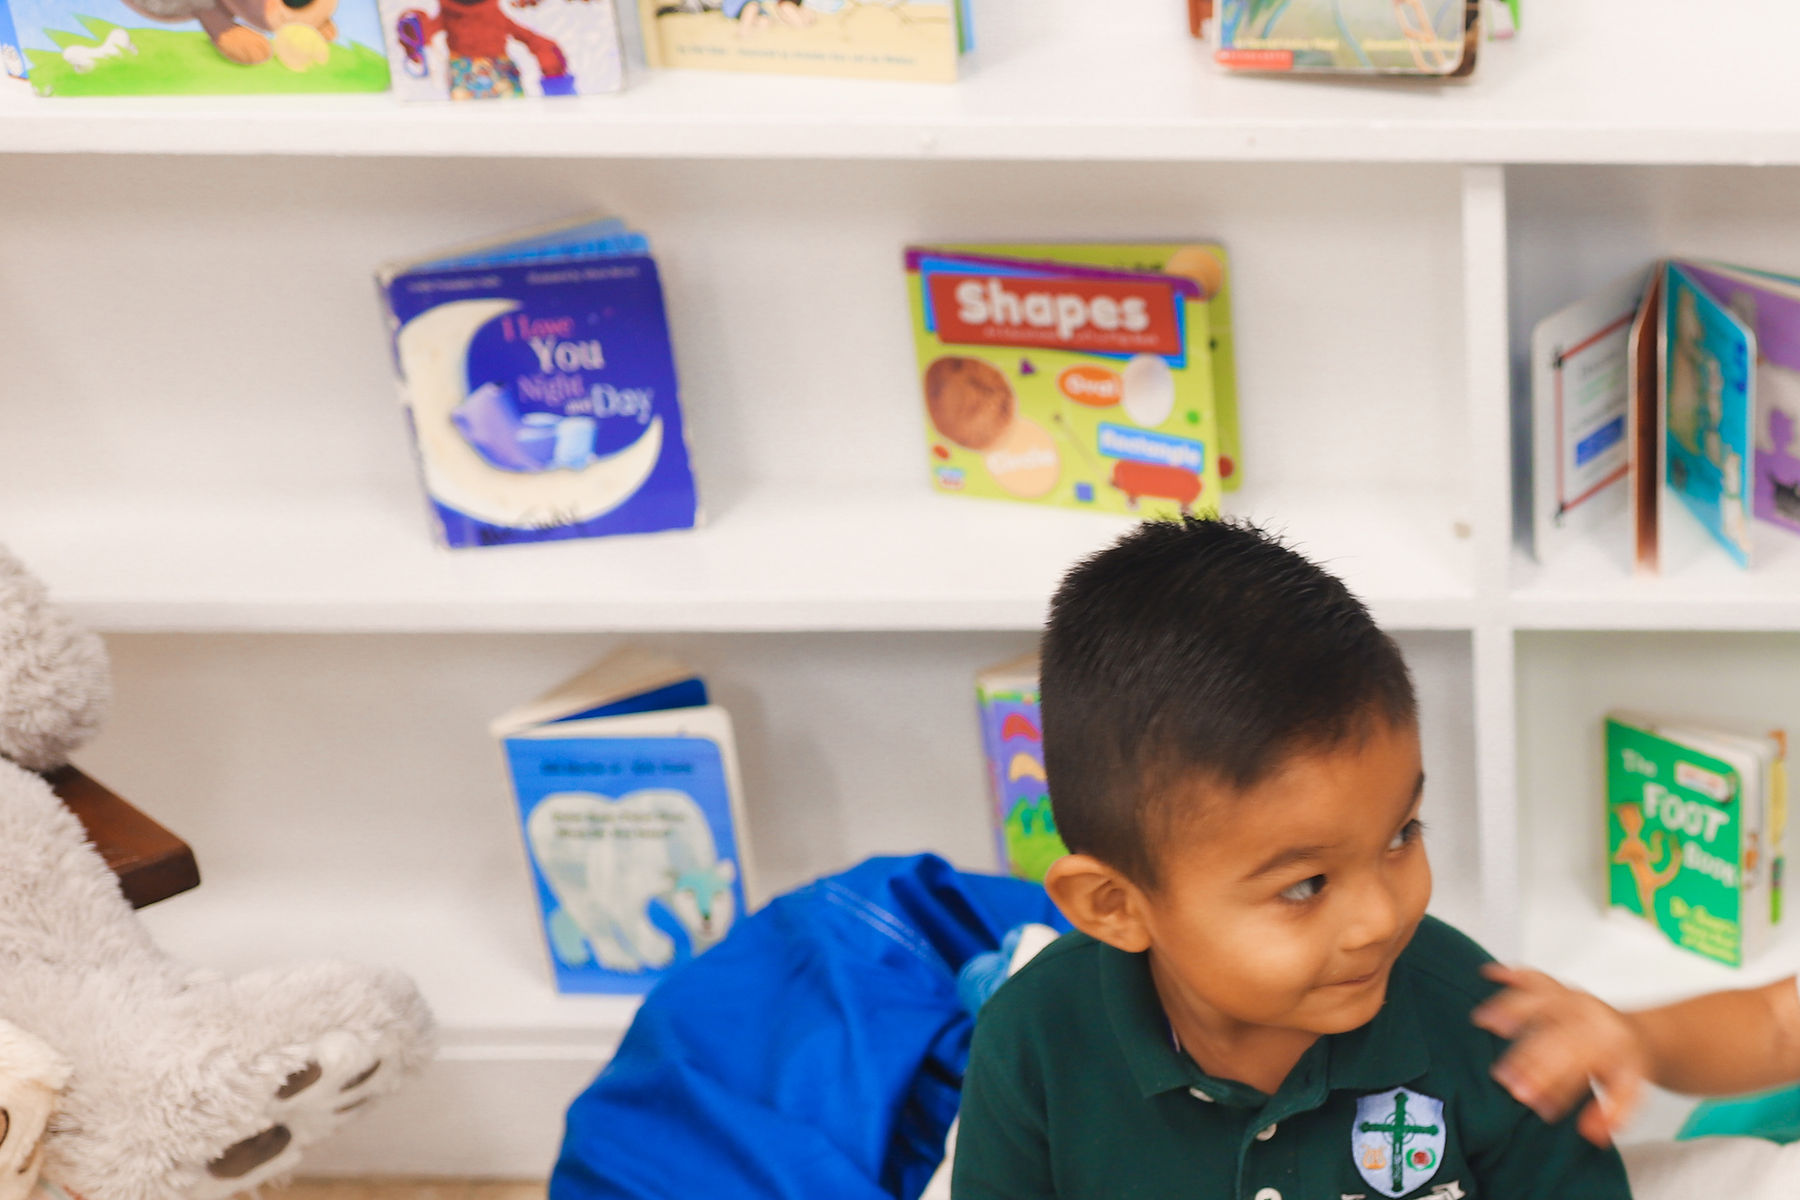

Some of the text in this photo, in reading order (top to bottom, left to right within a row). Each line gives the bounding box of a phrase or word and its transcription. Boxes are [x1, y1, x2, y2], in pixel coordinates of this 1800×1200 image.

[954, 277, 1150, 340] Shapes
[529, 333, 605, 374] You
[517, 374, 585, 405] Night
[590, 382, 653, 424] Day
[1642, 782, 1730, 843] FOOT
